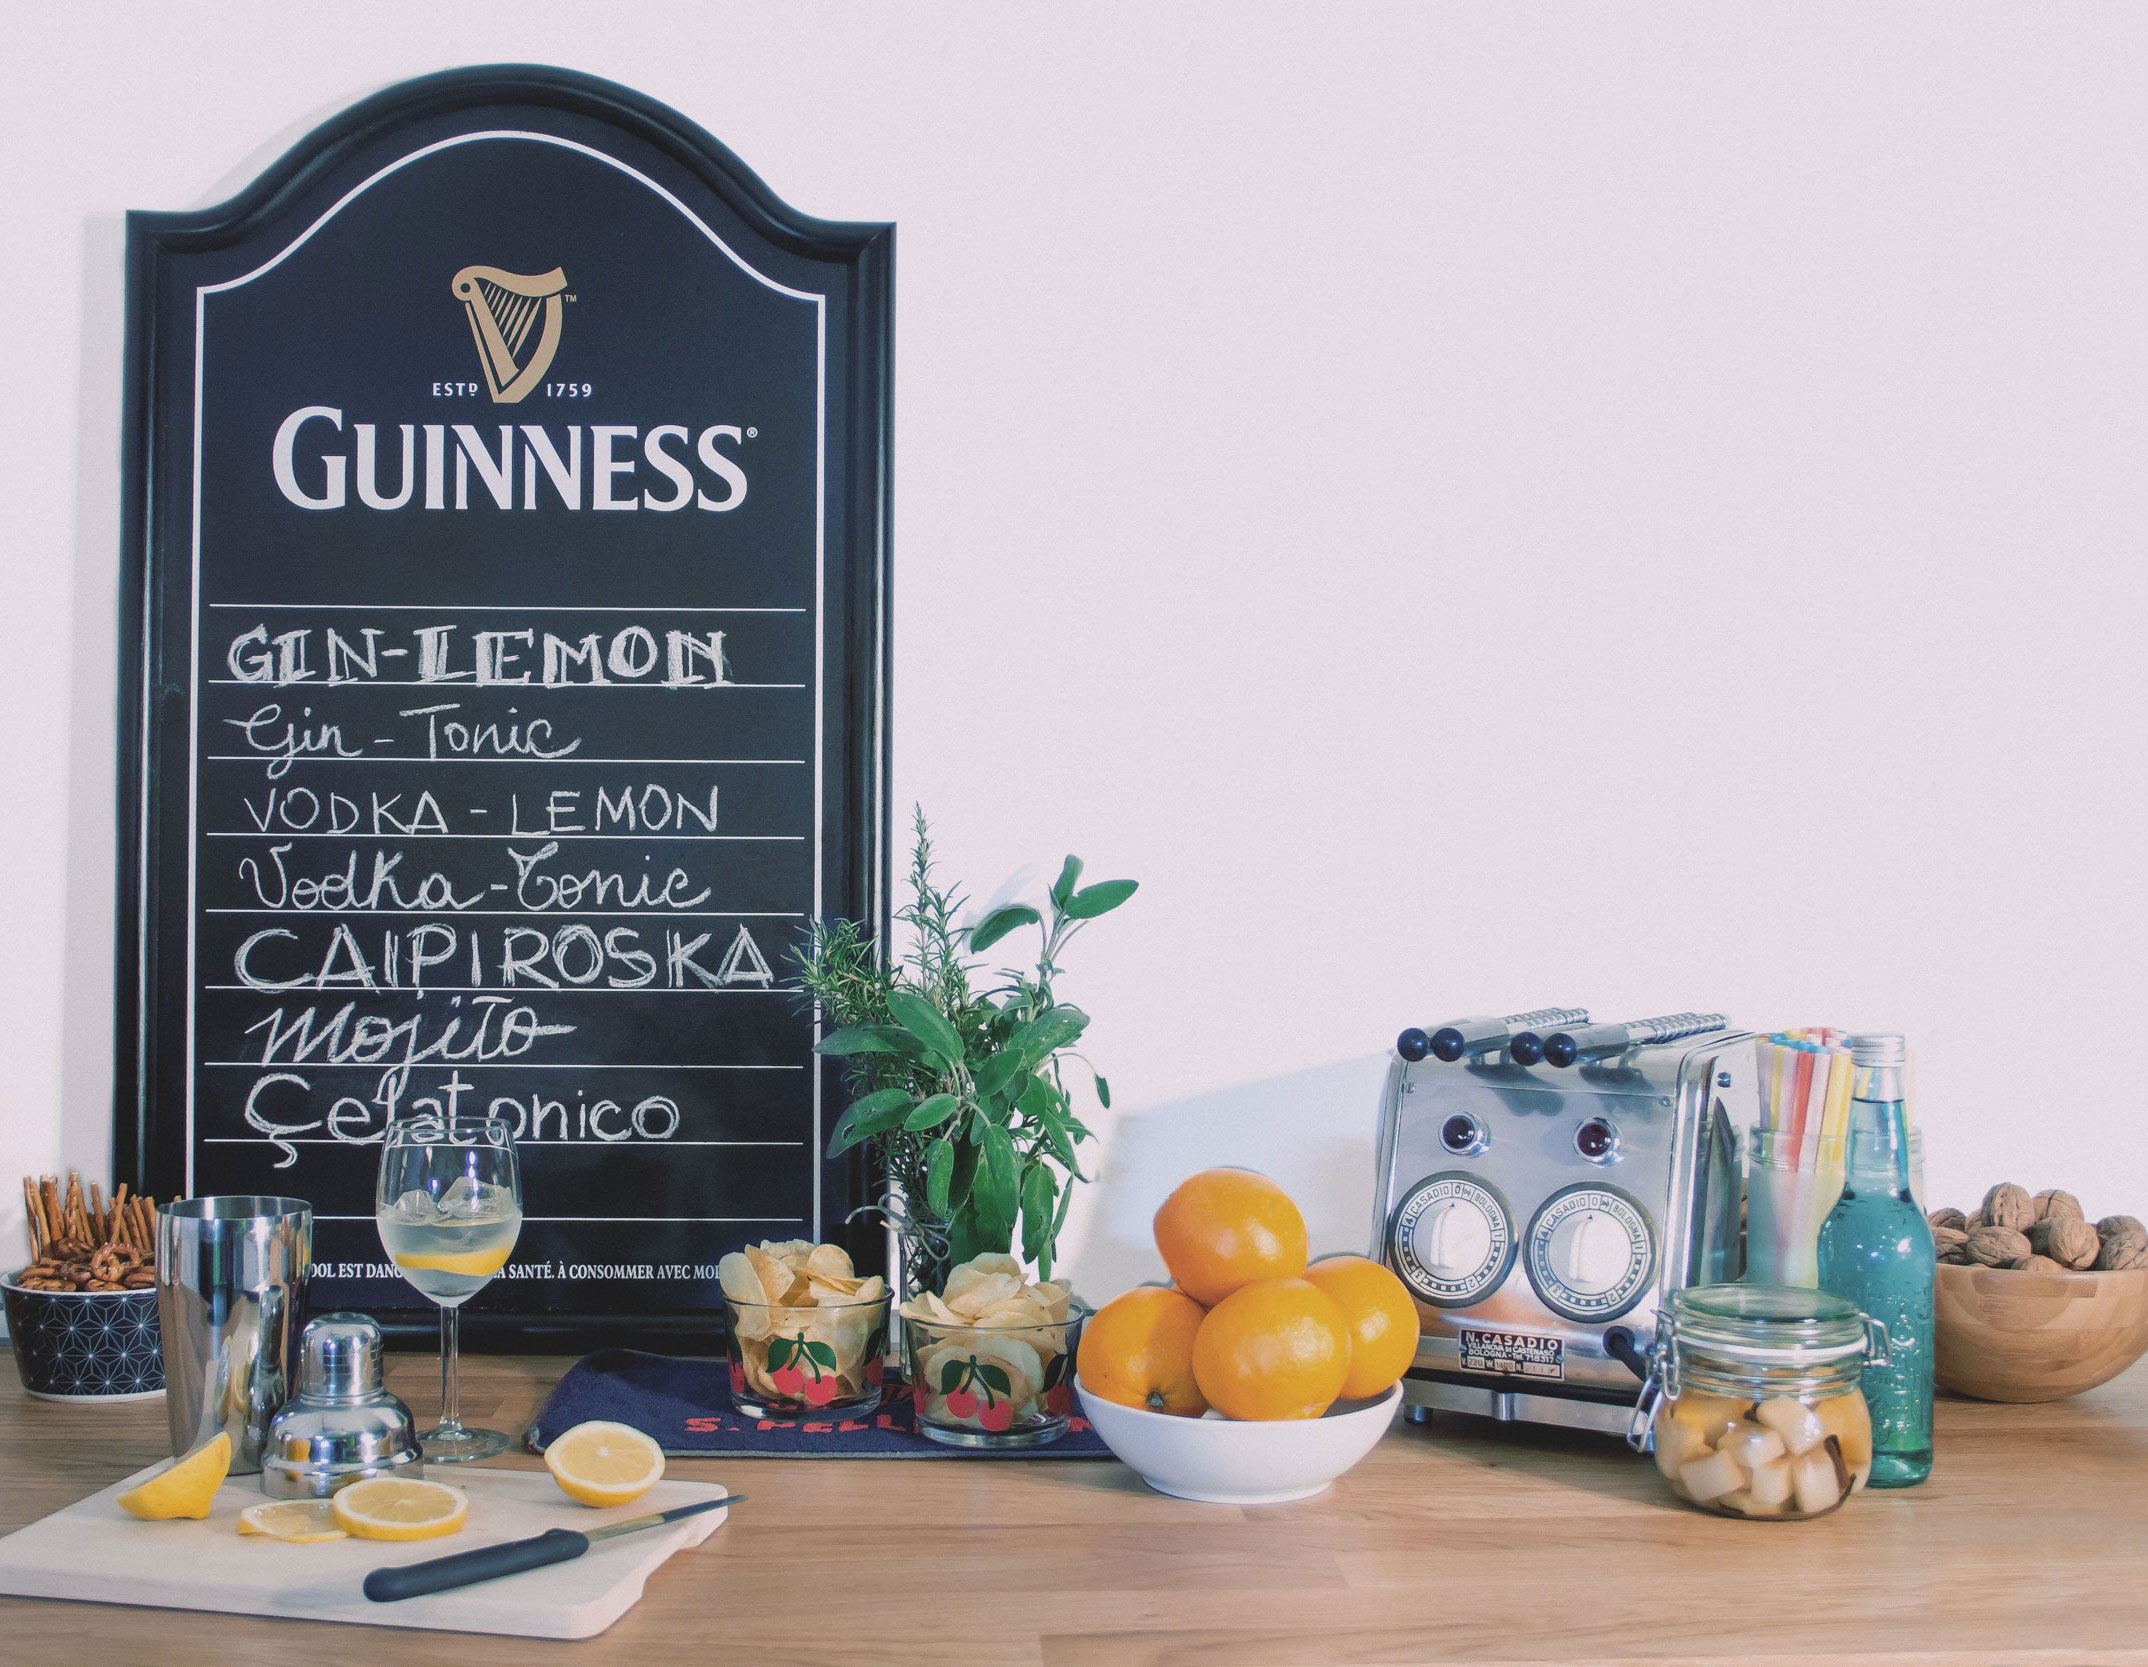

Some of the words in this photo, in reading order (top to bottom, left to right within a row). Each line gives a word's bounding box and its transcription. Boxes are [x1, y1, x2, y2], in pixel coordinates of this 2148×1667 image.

[546, 383, 592, 397] 1759
[227, 624, 734, 689] GIN-LEMON
[244, 787, 449, 835] VODKA
[511, 784, 719, 837] LEMON
[234, 923, 776, 993] CAIPIROSKA
[244, 989, 578, 1103] Mojito
[1411, 1185, 1450, 1215] CASADIO
[1474, 1193, 1501, 1228] BOLOGNA
[1545, 1197, 1586, 1225] CASADIO
[1612, 1204, 1641, 1238] BOLOGNA
[338, 1263, 364, 1278] EST
[508, 1260, 555, 1279] SANTÉ.
[557, 1260, 567, 1279] À
[569, 1264, 654, 1279] CONSOMMER
[657, 1264, 690, 1279] AVEC
[1467, 1342, 1504, 1352] VILLANOVA
[1512, 1346, 1555, 1357] CASTENASO
[1468, 1348, 1508, 1359] BOLOGNA
[1482, 1333, 1558, 1351] CASADIO
